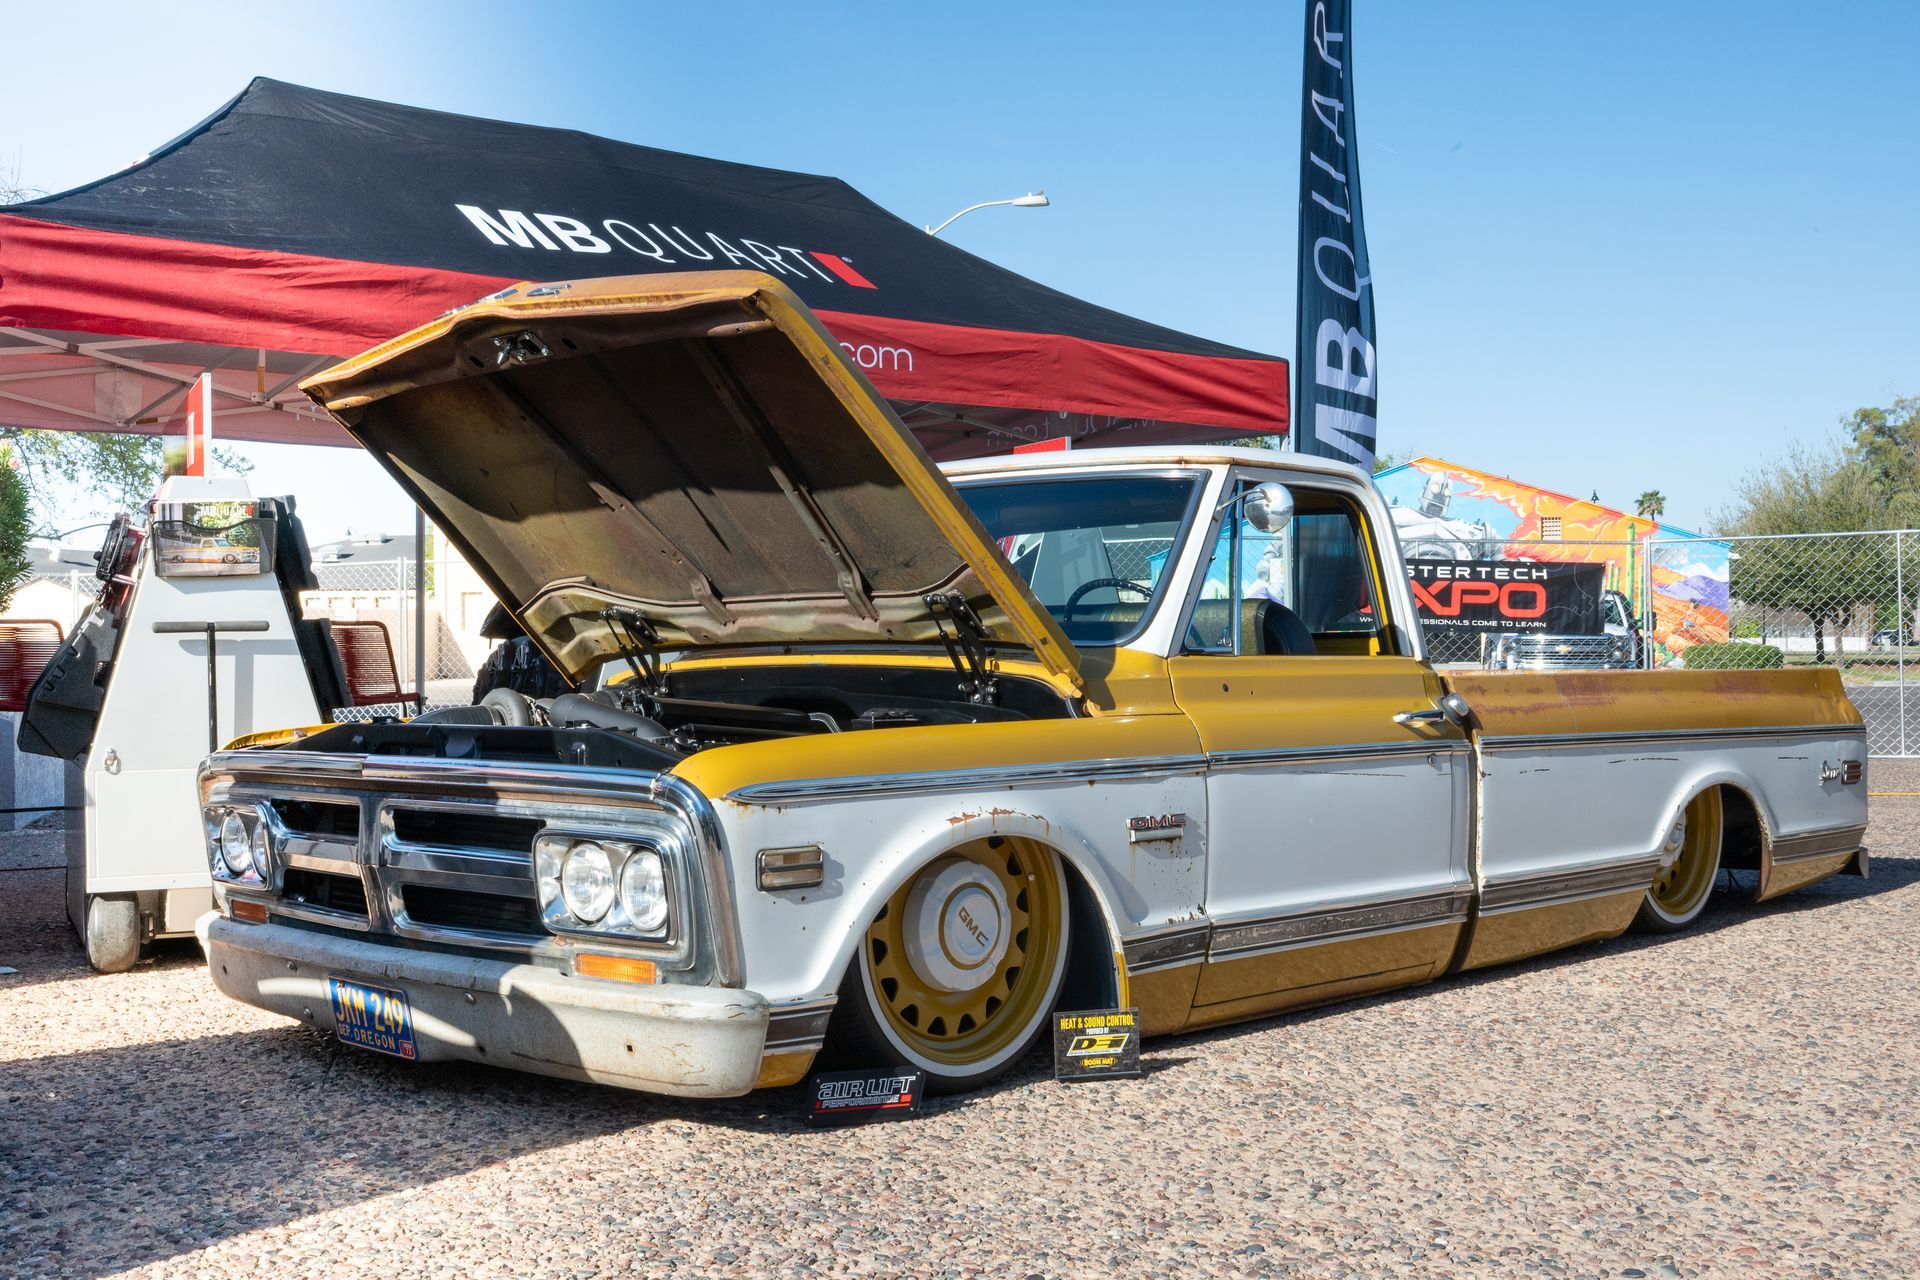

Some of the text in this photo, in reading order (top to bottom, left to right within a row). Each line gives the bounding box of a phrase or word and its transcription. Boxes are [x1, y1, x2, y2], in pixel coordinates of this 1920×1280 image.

[455, 204, 834, 284] MBQUART
[1407, 566, 1548, 580] STER TECH
[1411, 580, 1547, 618] XPO
[1419, 618, 1469, 626] ESSIONALS
[1515, 621, 1547, 629] LEARN
[1126, 812, 1186, 831] GMC
[958, 905, 989, 948] GMC
[370, 993, 403, 1034] 249
[1060, 1013, 1134, 1030] HEAT & SOUND CONTROL
[353, 1028, 395, 1049] OREGON
[1084, 1057, 1113, 1066] BOOM MAT
[865, 1076, 916, 1095] LIFT
